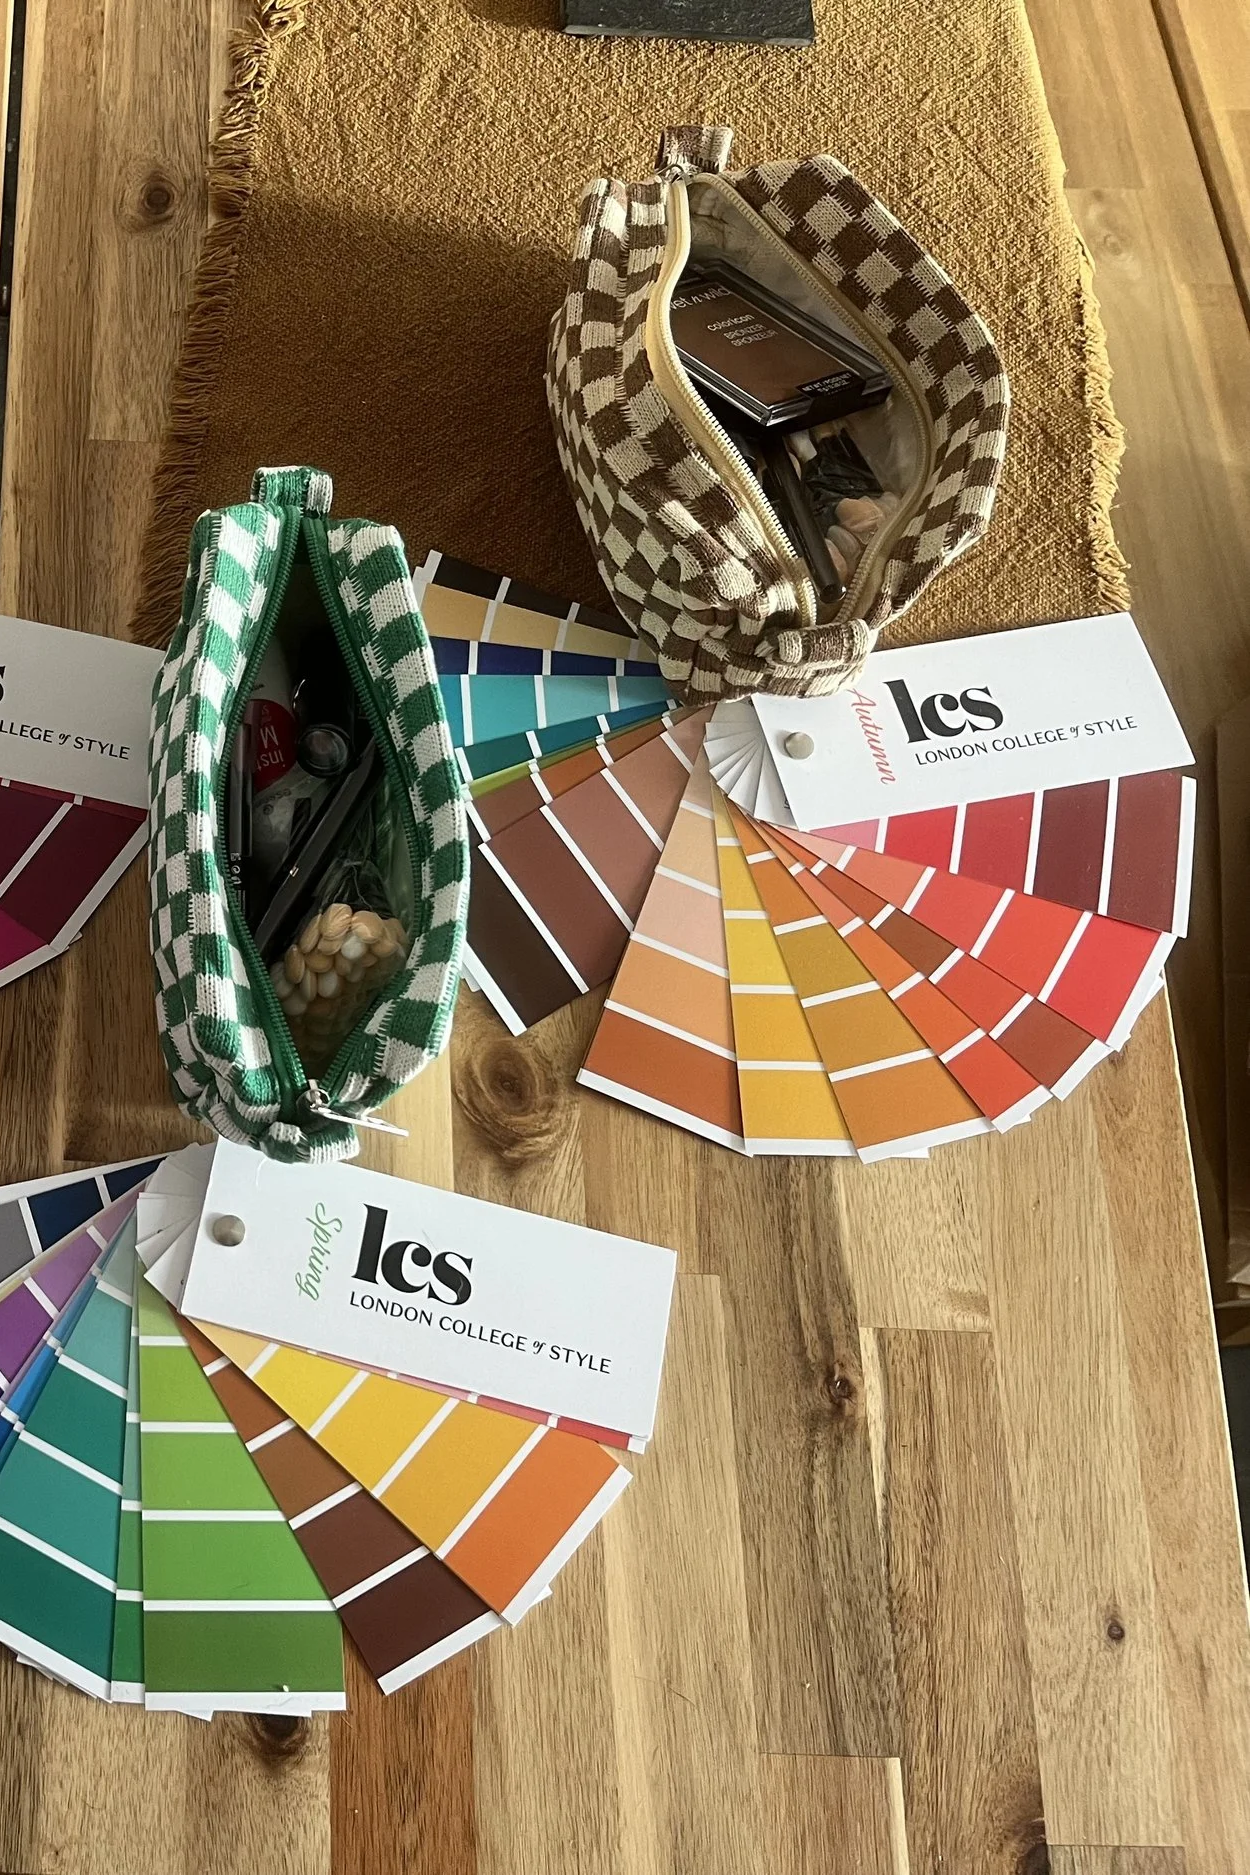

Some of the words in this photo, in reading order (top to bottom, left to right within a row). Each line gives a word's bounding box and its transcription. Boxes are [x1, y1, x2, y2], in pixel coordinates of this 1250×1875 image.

[701, 286, 731, 300] wild
[58, 732, 71, 746] of
[73, 736, 131, 761] STYLE
[256, 749, 286, 772] inst
[849, 687, 896, 786] Autumn
[915, 742, 989, 765] LONDON
[992, 728, 1069, 751] COLLEGE
[1070, 725, 1081, 739] of
[1084, 715, 1138, 736] STYLE
[295, 1202, 343, 1301] Spring
[350, 1290, 433, 1327] LONDON
[439, 1315, 528, 1353] COLLEGE
[532, 1339, 547, 1356] of
[549, 1344, 612, 1375] STYLE
